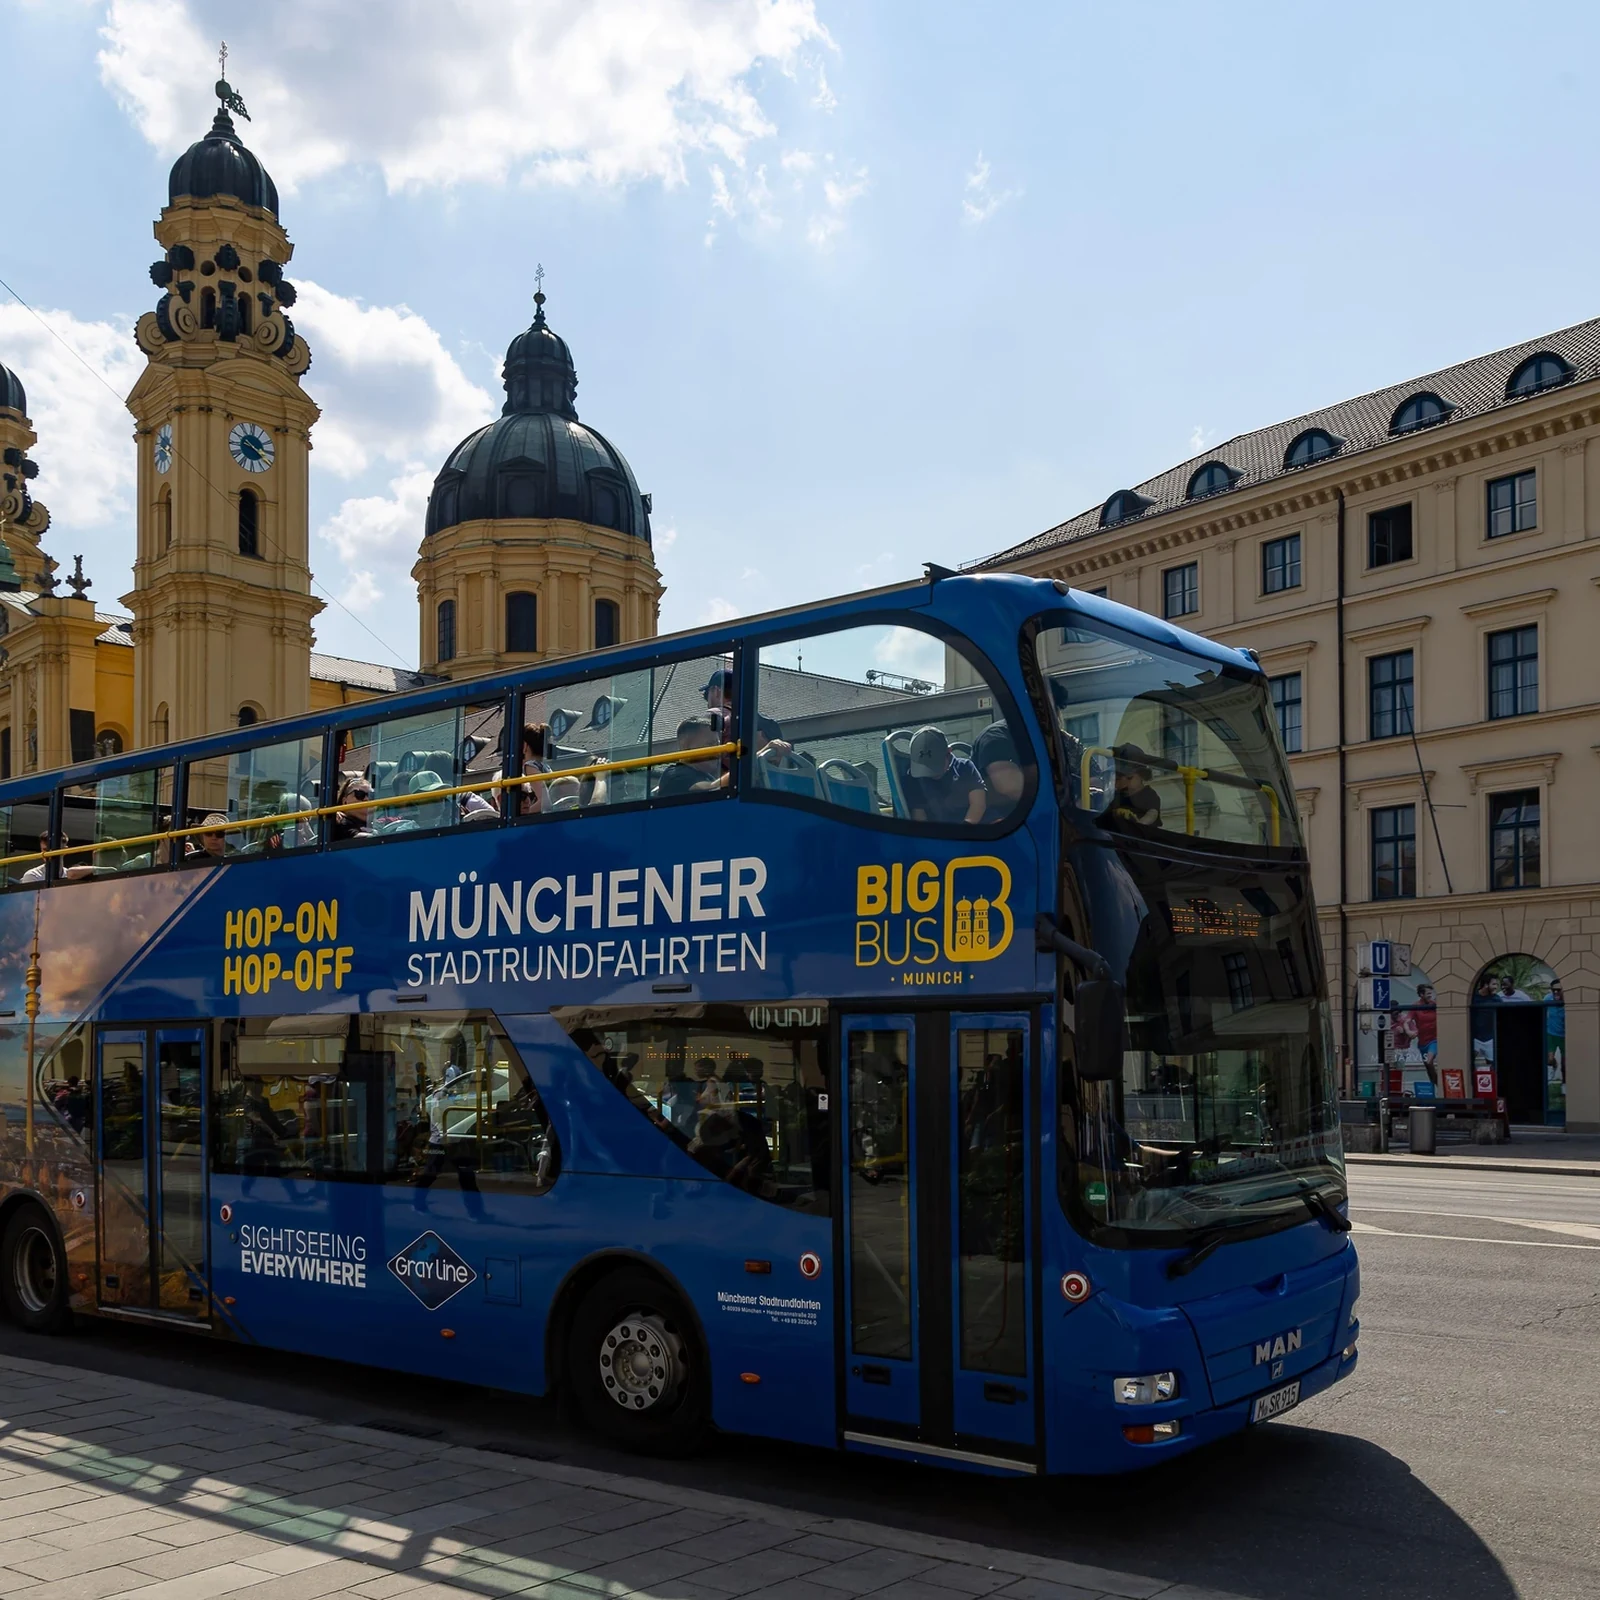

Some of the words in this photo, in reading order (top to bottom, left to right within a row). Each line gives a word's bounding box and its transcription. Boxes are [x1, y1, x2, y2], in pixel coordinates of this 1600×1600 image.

[408, 856, 768, 943] MÜNCHENER
[856, 860, 940, 916] BIG
[225, 898, 338, 949] HOP-ON
[855, 917, 939, 967] BUS
[224, 946, 354, 996] HOP-OFF
[406, 930, 767, 987] STADTRUNDFAHRTEN
[903, 971, 963, 985] MUNICH
[1375, 946, 1387, 970] U
[240, 1224, 366, 1261] SIGHTSEEING
[241, 1249, 366, 1288] EVERYWHERE
[717, 1291, 758, 1305] Münchener
[758, 1295, 821, 1310] Stadtrundfahrten
[1255, 1328, 1302, 1366] MAN
